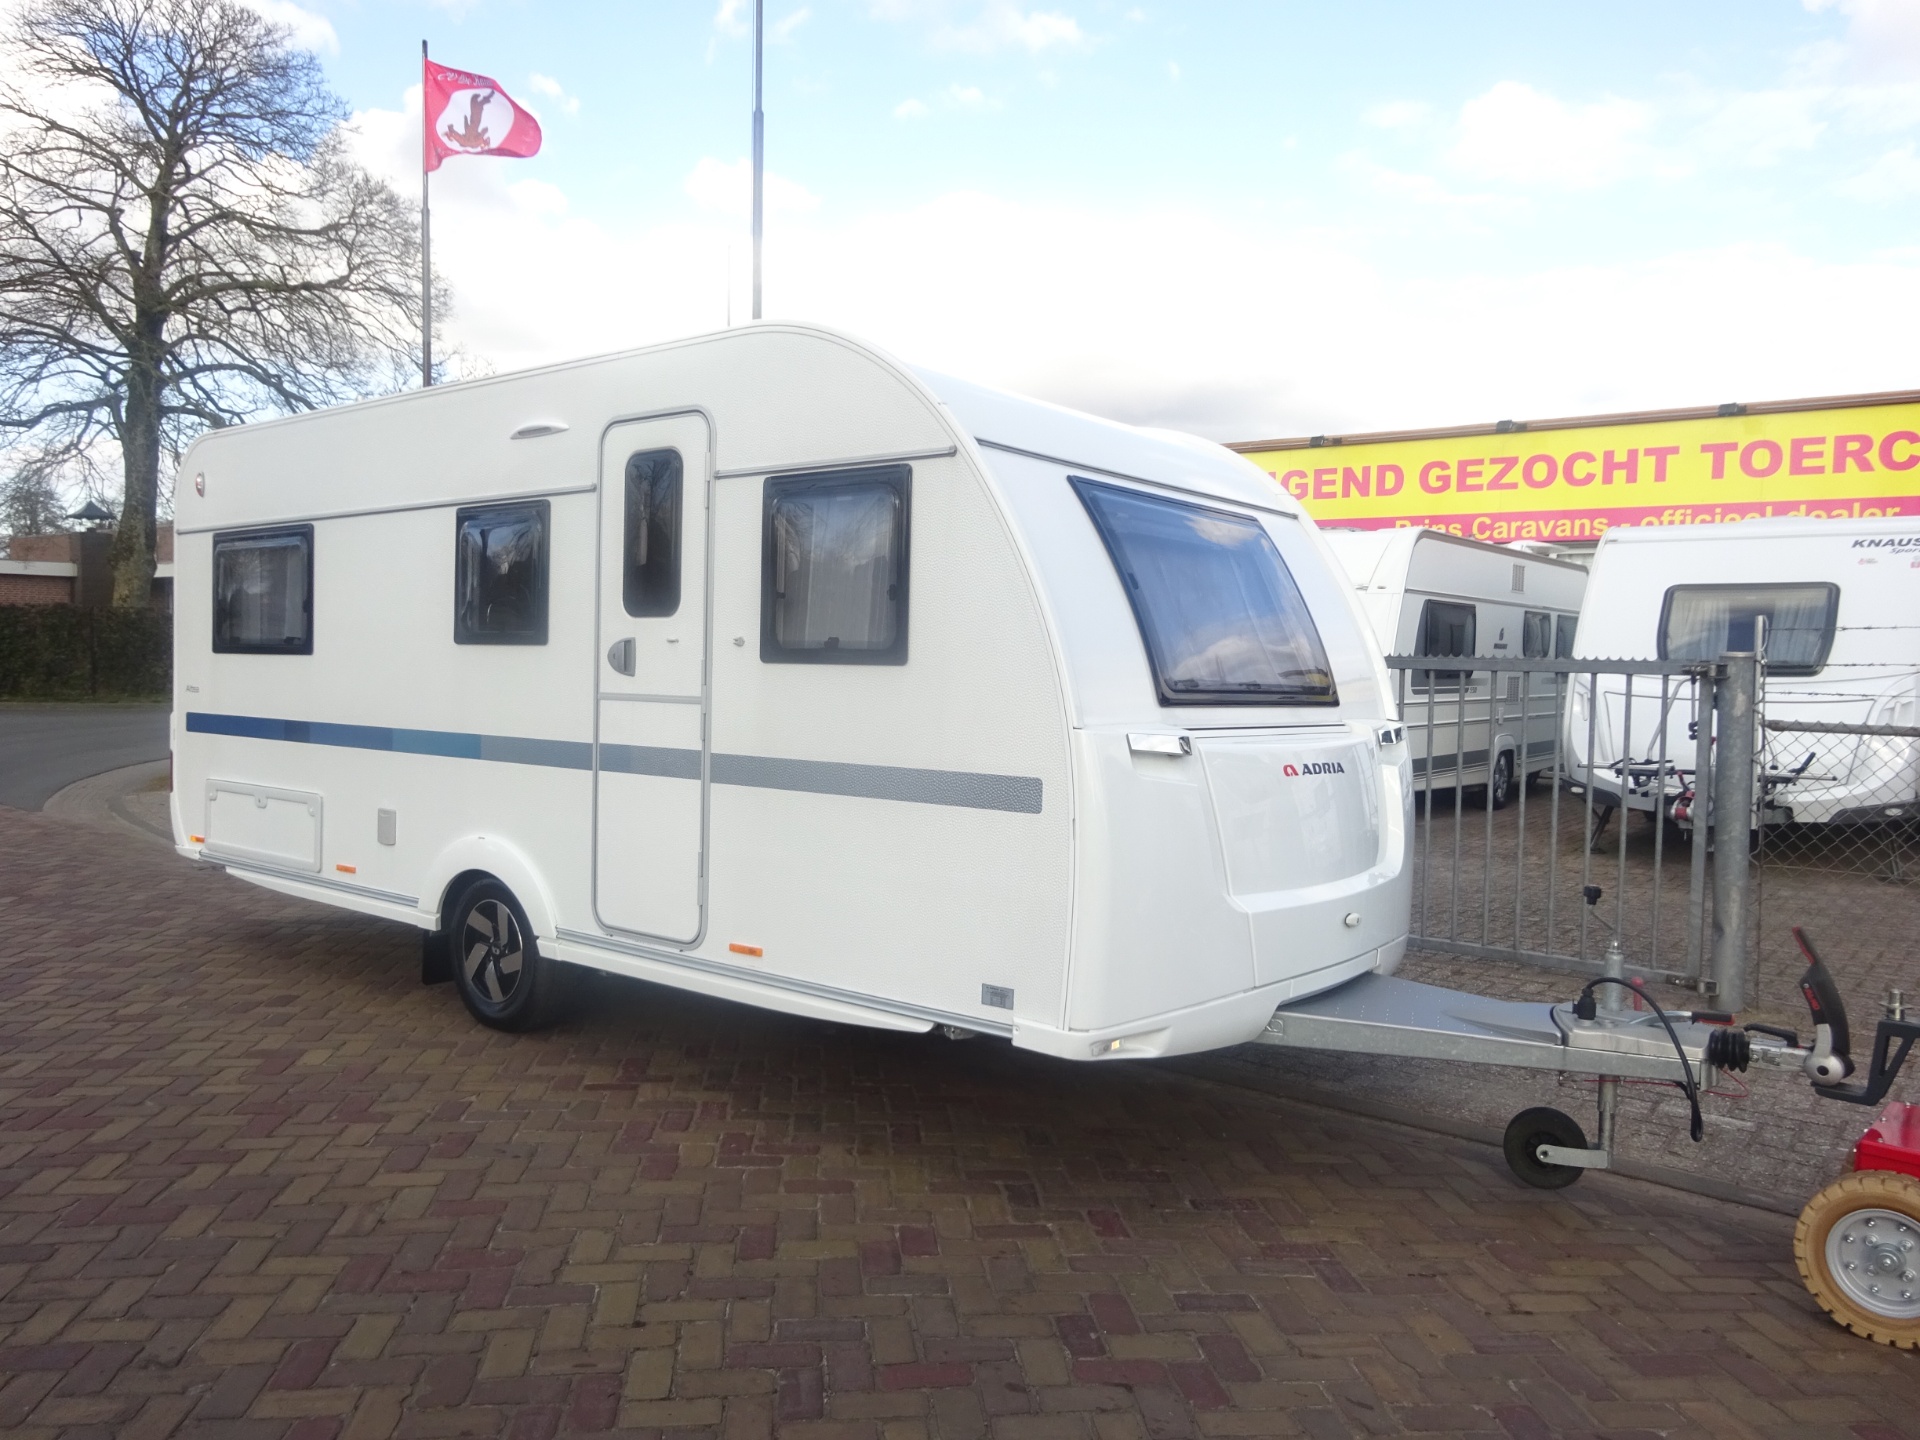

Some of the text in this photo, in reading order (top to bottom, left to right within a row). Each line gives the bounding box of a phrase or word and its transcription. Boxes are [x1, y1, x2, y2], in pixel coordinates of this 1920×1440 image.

[1418, 445, 1681, 495] GEZOCHT
[1700, 430, 1920, 480] TOERC
[1472, 514, 1608, 540] Caravans
[1851, 537, 1920, 548] KNAUS
[1302, 762, 1345, 776] ADRIA
